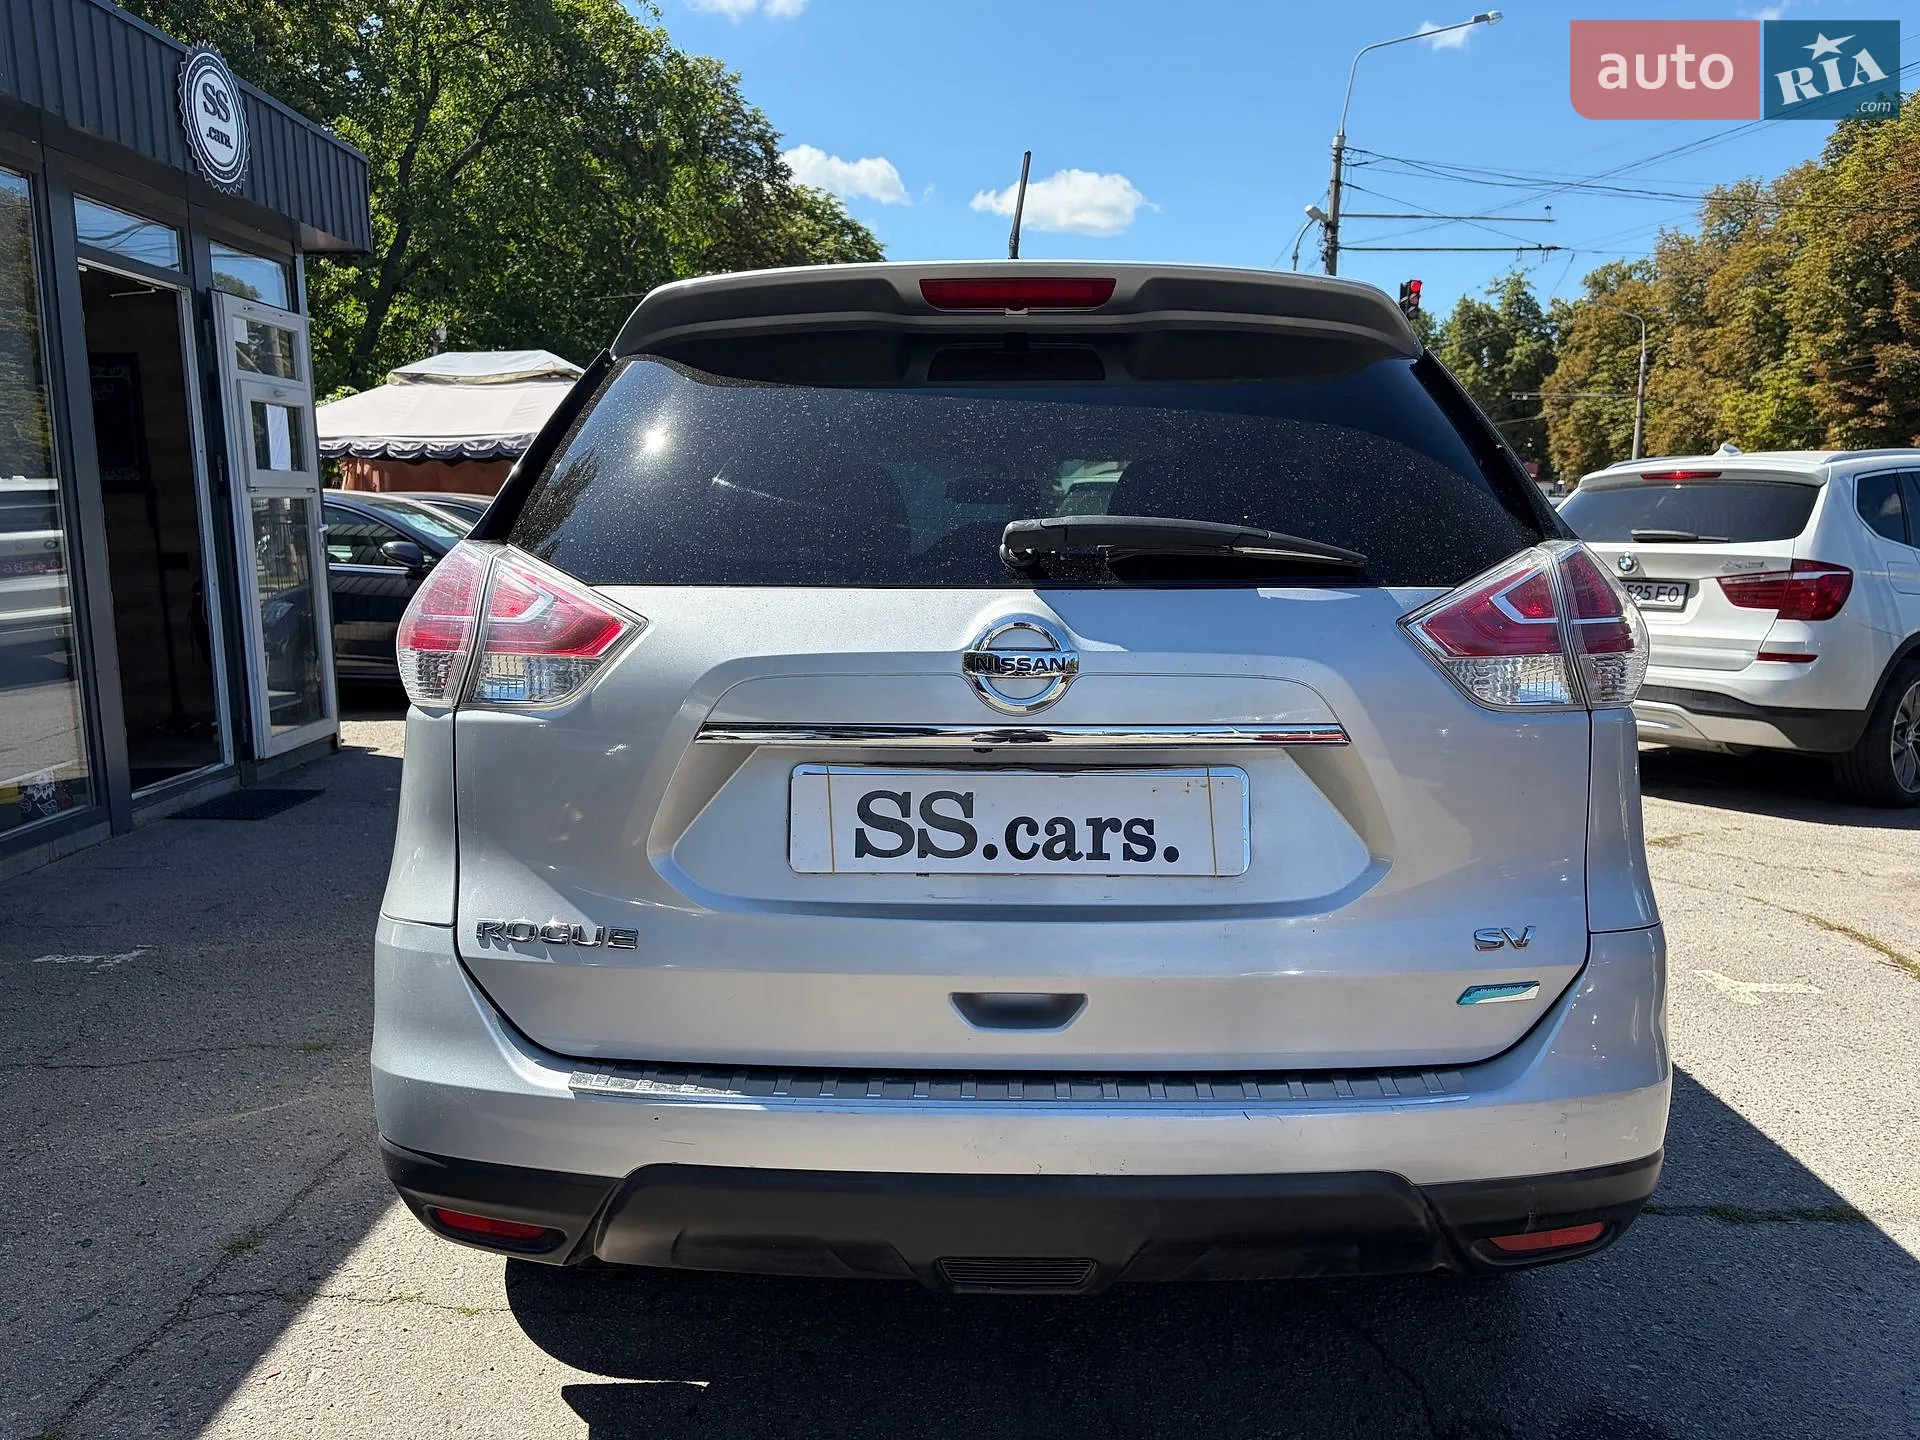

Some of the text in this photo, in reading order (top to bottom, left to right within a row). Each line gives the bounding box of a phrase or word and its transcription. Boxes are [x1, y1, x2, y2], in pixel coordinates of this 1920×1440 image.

[202, 82, 231, 123] SS
[1623, 584, 1679, 602] 525 EO
[975, 656, 1066, 672] NISSAN
[854, 789, 1180, 863] SS.cars.
[475, 918, 639, 951] ROGUE
[1473, 925, 1536, 952] SV
